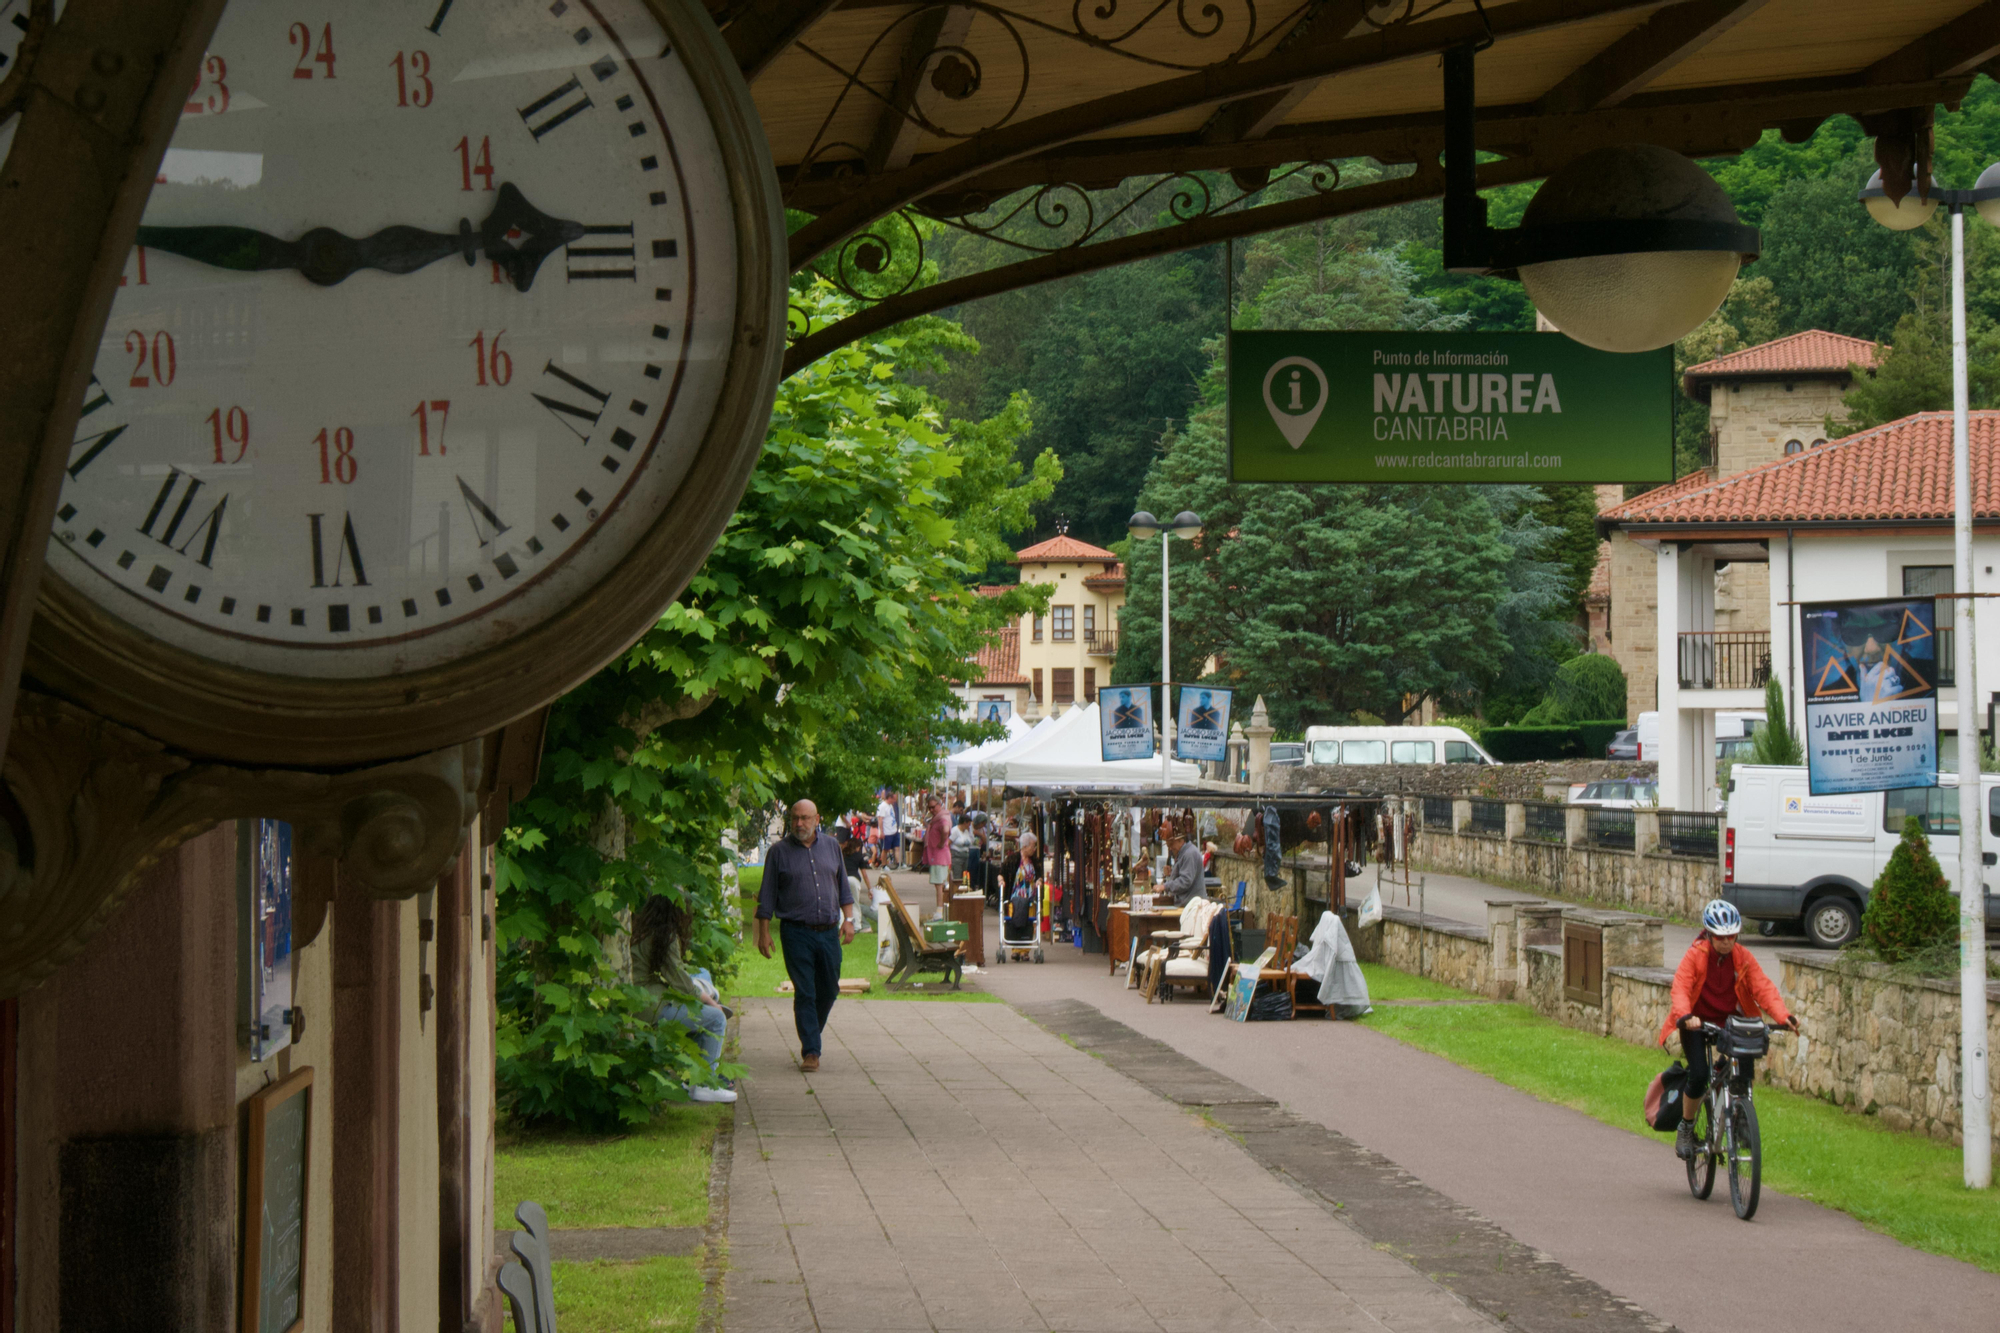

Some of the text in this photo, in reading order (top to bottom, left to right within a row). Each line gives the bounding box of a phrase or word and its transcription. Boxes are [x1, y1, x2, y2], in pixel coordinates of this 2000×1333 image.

[289, 22, 337, 79] 24
[389, 50, 433, 108] 13
[517, 73, 595, 143] II
[453, 135, 495, 191] 14
[125, 330, 177, 388] 20
[469, 330, 513, 387] 16
[1373, 349, 1509, 366] Punto de Información
[530, 359, 611, 445] IV
[1373, 373, 1562, 414] NATUREA
[205, 406, 250, 464] 19
[312, 427, 358, 484] 18
[411, 400, 450, 456] 17
[1373, 416, 1509, 441] CANTABRIA
[1375, 451, 1562, 468] www.redcantabrarural.com
[456, 475, 511, 547] V
[306, 511, 372, 588] VI
[1105, 729, 1132, 737] JACOBO
[1180, 728, 1224, 738] JACOBO SERRA
[1815, 709, 1927, 729] JAVIER ANDREU
[1828, 727, 1914, 741] ENTRE LUCES
[1822, 748, 1860, 757] PUENTE
[1906, 743, 1927, 752] 2024
[1849, 753, 1893, 764] 1 de Junio
